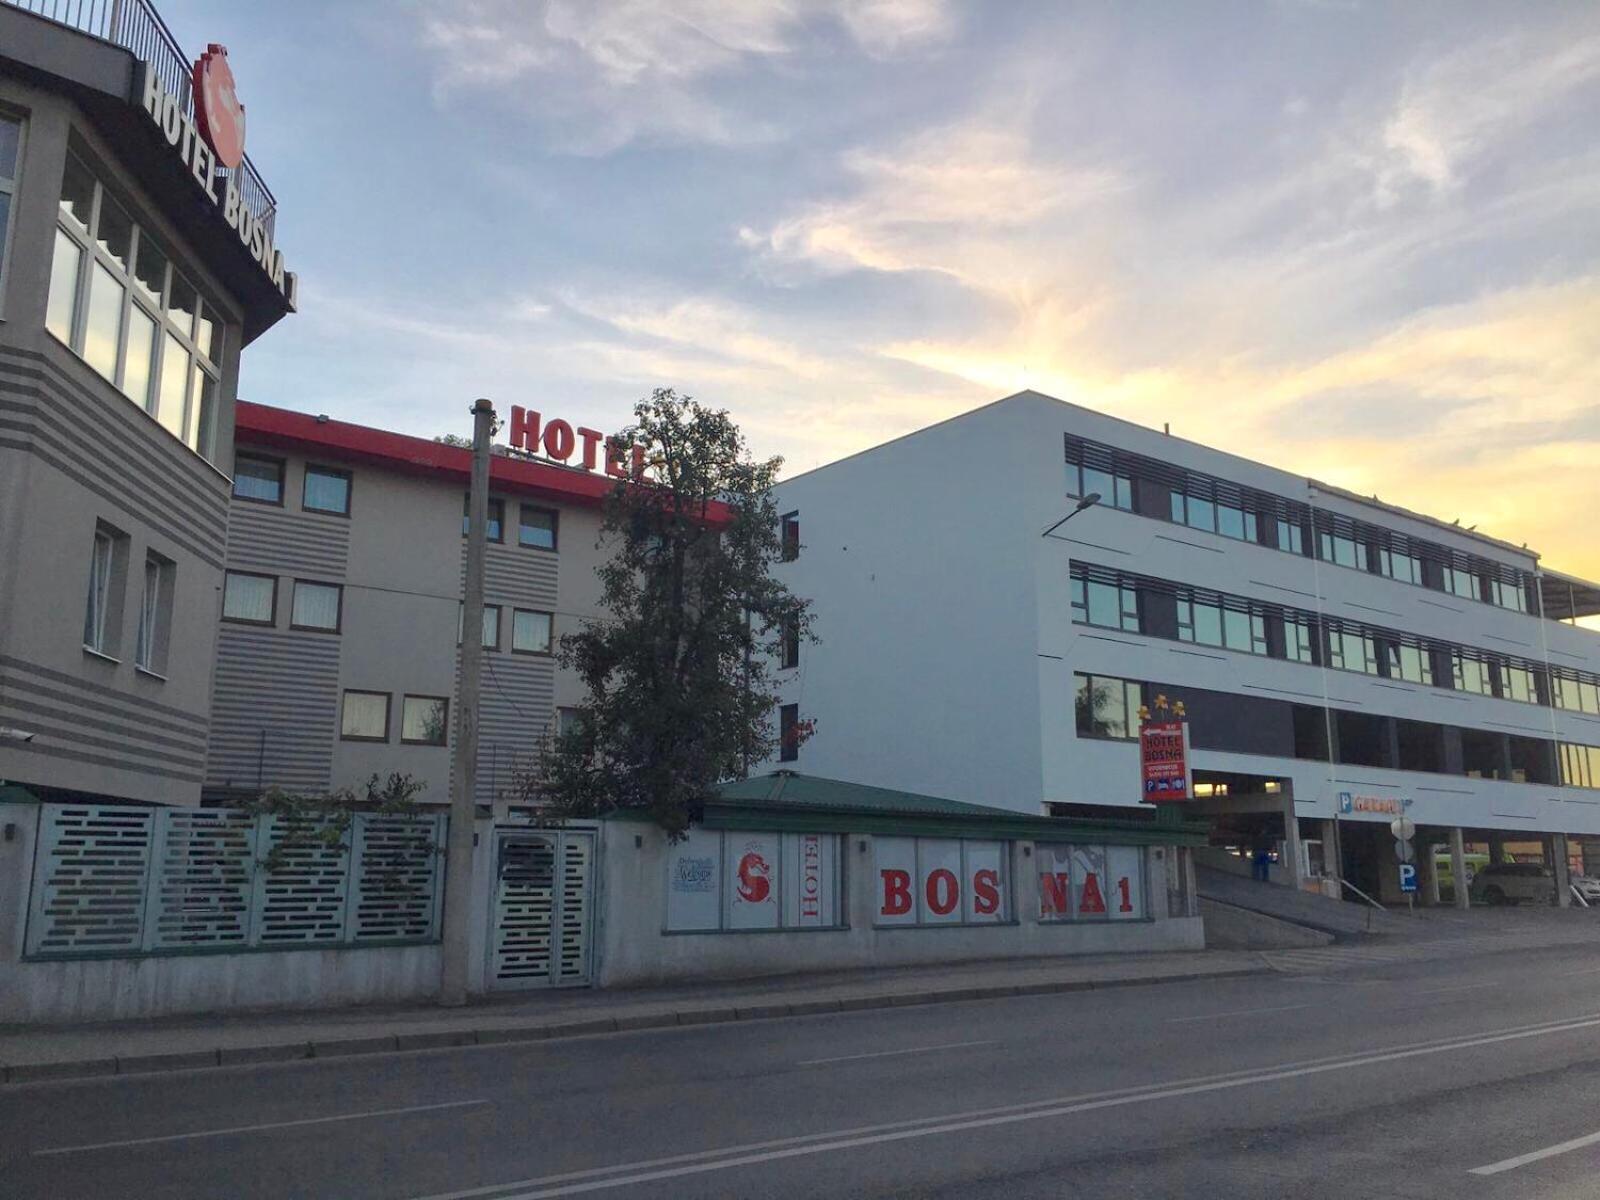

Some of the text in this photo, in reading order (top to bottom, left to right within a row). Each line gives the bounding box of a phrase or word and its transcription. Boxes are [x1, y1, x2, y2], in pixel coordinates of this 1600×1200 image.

[143, 60, 218, 206] HOTEL
[223, 180, 285, 296] BOSNA
[1146, 735, 1180, 749] HOTEL
[1399, 864, 1416, 888] P
